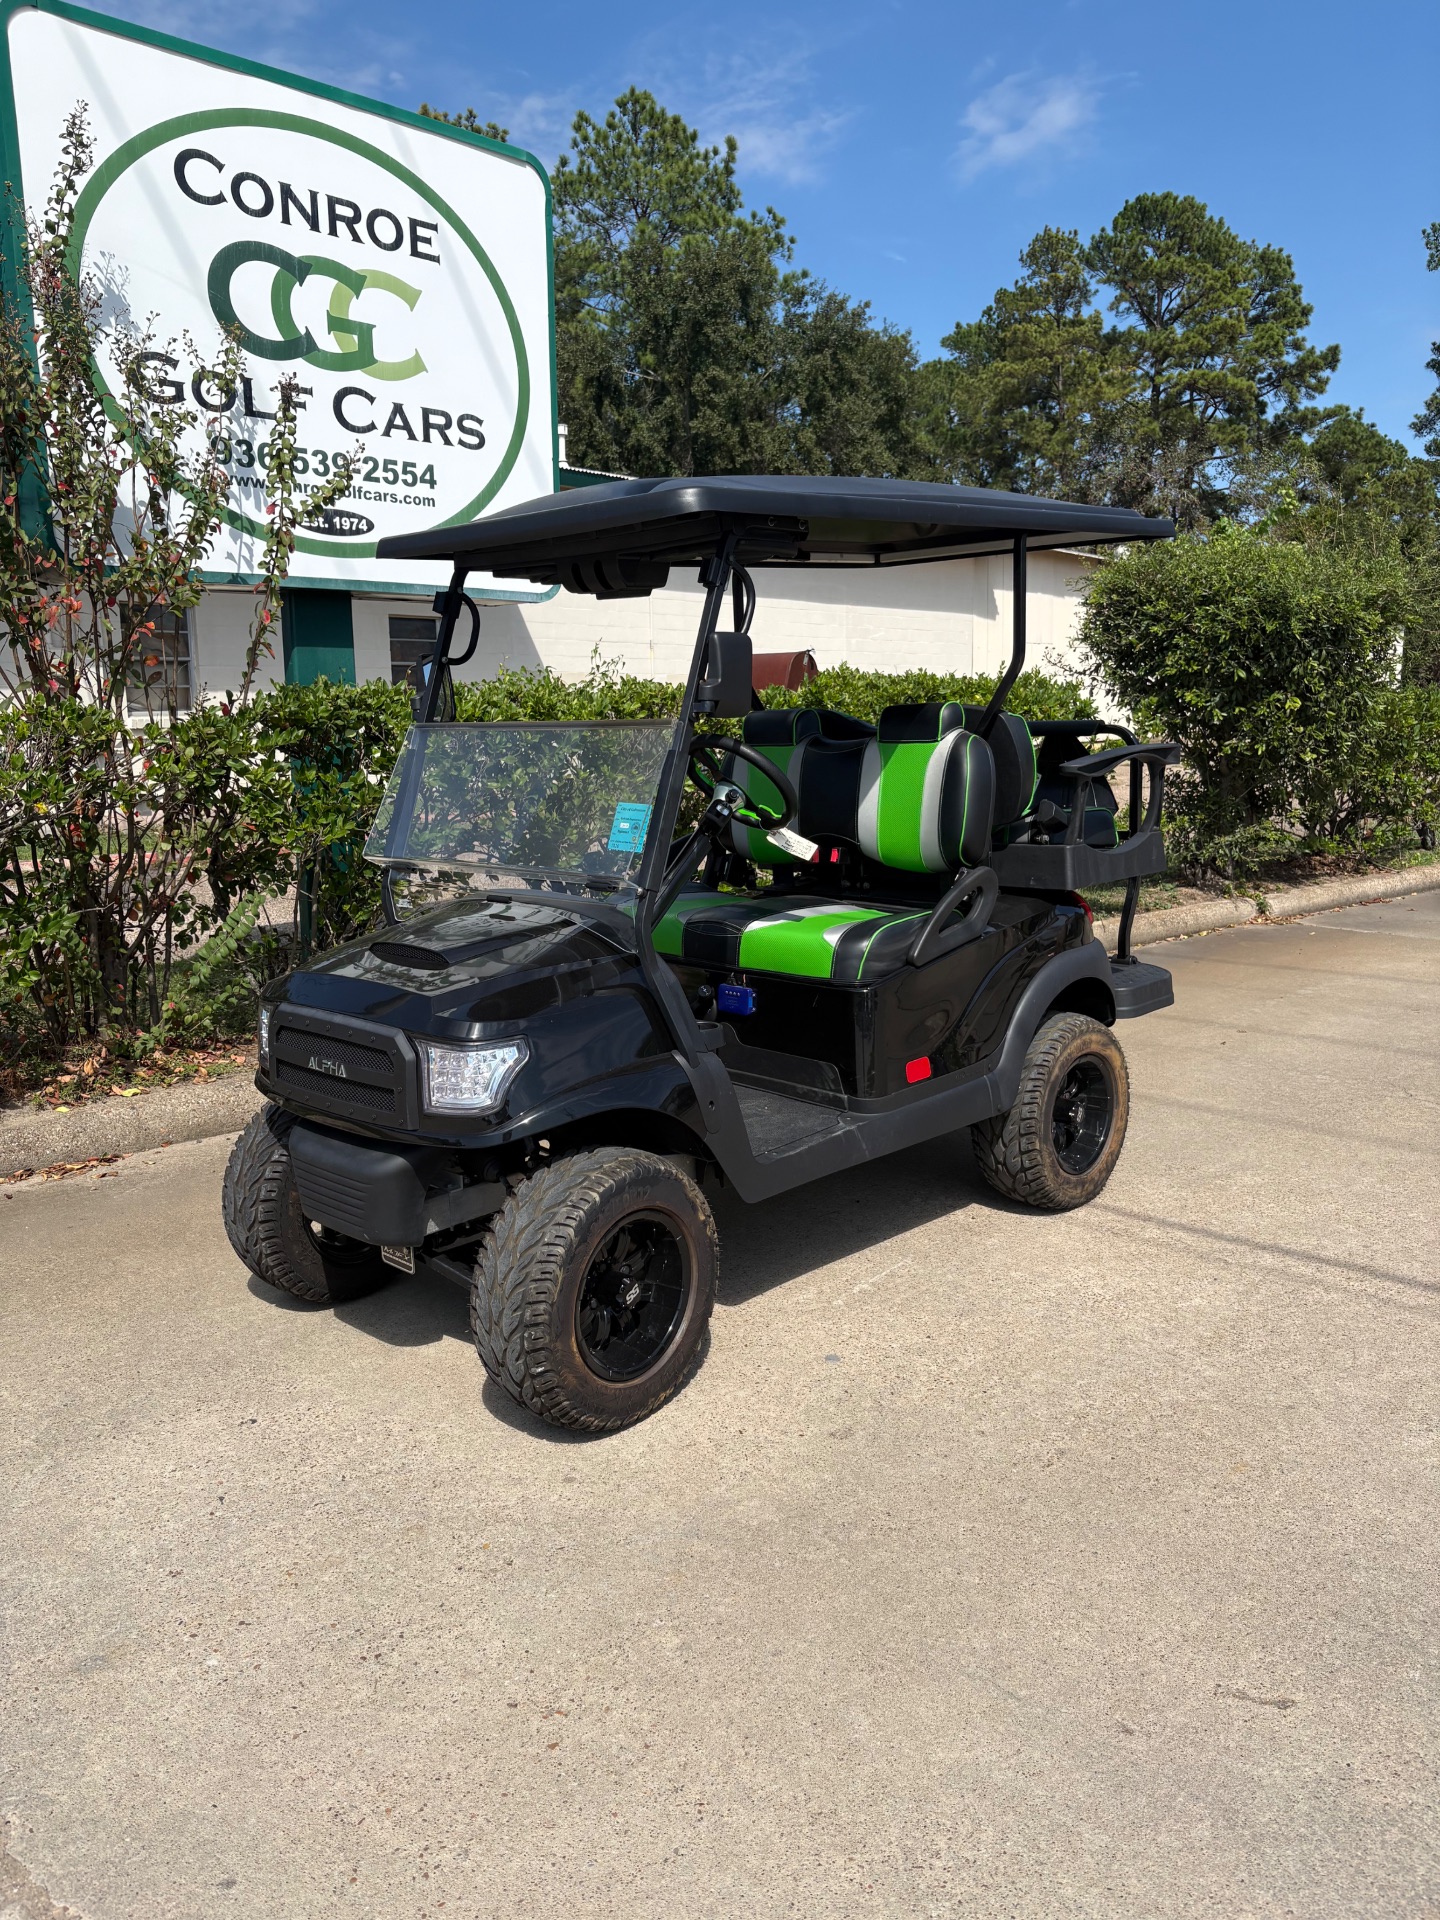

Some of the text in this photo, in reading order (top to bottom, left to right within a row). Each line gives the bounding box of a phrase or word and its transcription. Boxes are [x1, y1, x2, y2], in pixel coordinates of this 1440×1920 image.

[173, 148, 441, 265] CONROE
[126, 351, 486, 450] GOLF CARS
[300, 511, 368, 532] Est. 1974
[308, 1056, 346, 1078] ALPHA
